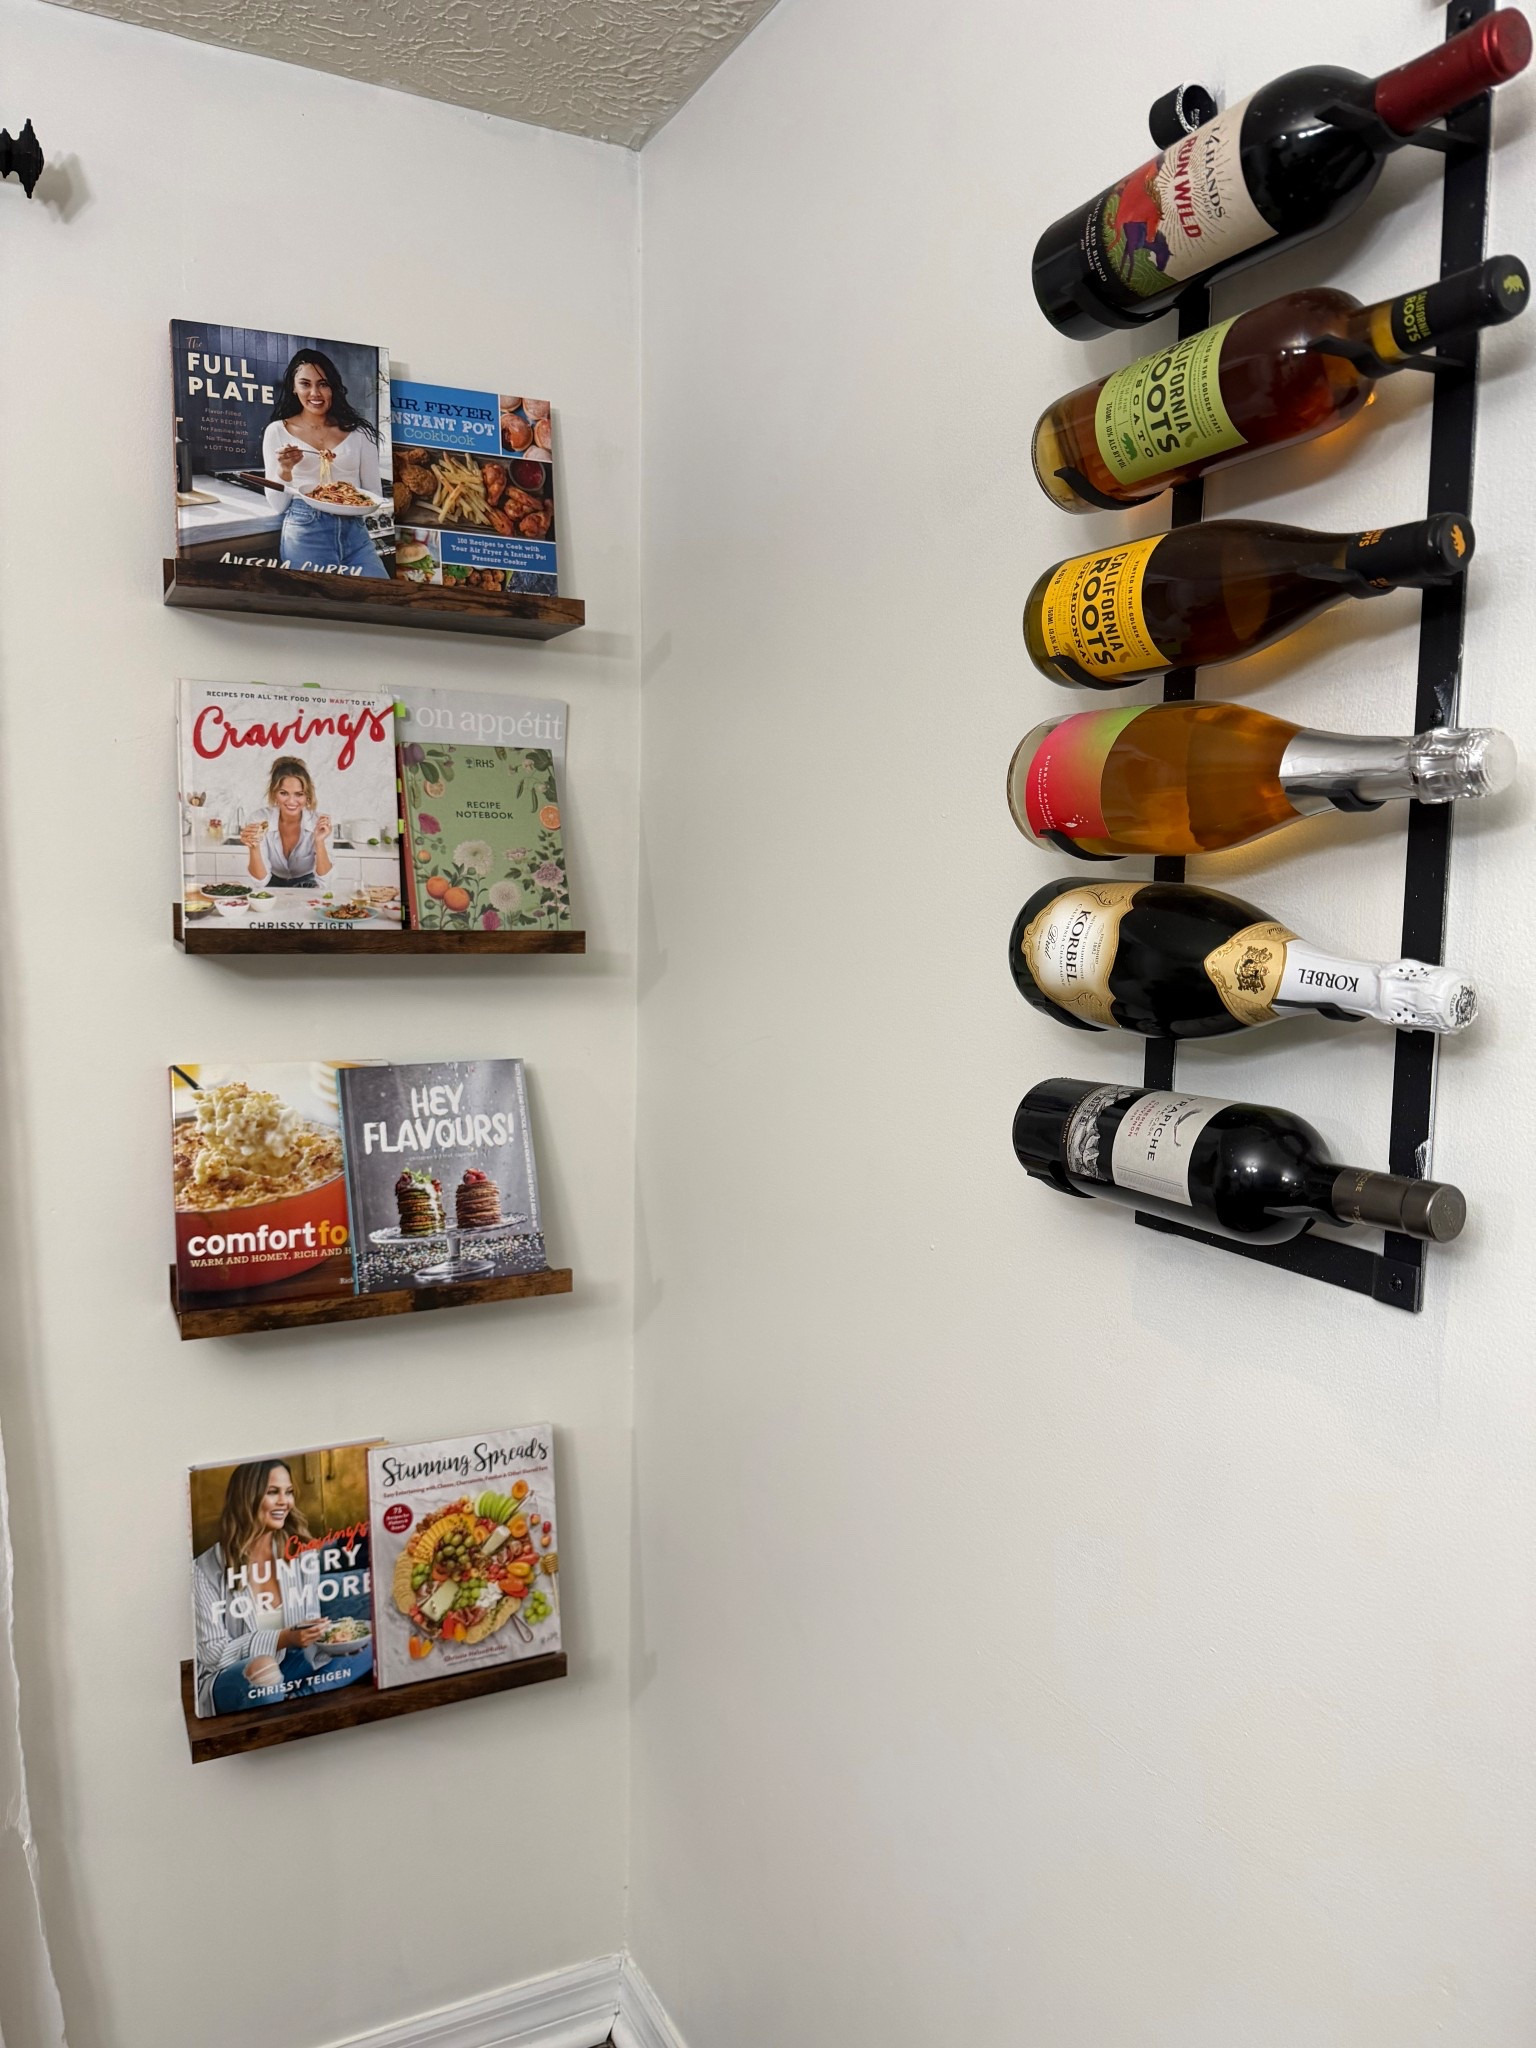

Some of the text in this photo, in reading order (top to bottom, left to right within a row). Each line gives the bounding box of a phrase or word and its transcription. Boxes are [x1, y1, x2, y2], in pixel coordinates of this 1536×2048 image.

[1174, 135, 1199, 179] RUN
[1200, 183, 1214, 220] WINERY
[1205, 149, 1226, 219] HANDS
[1174, 179, 1202, 238] WILD
[1086, 247, 1095, 270] VALLEY
[1092, 249, 1108, 282] BLEND
[1403, 295, 1421, 342] ROOTS
[1415, 290, 1432, 338] CALIFORNIA
[185, 335, 203, 350] The
[187, 352, 255, 379] FULL
[188, 376, 275, 405] PLATE
[1202, 383, 1212, 412] GOLDEN
[1209, 413, 1224, 433] STATE
[220, 418, 247, 427] RECIPES
[391, 411, 495, 437] NSTANT POT
[425, 401, 494, 422] FRYER
[404, 427, 476, 446] Cookbook
[469, 538, 496, 548] Recipes
[506, 542, 523, 551] Cook
[472, 554, 527, 566] Pressure Cooker
[482, 548, 503, 557] Fryer
[511, 551, 534, 560] Instant
[1070, 561, 1095, 666] CHARDONNAY
[1082, 556, 1116, 665] ROOTS
[1101, 552, 1128, 652] CALIFORNIA
[1128, 612, 1139, 639] GOLDEN
[1138, 640, 1151, 657] STATE
[206, 690, 239, 698] RECIPES
[290, 695, 310, 703] FOOD
[193, 704, 395, 771] Cravings
[459, 711, 565, 744] appétit
[475, 758, 495, 769] RHS
[456, 811, 514, 820] NOTEBOOK
[466, 800, 501, 810] RECIPE
[249, 921, 354, 931] CHRISSY TEIGEN
[1061, 903, 1082, 943] CALIFORNIA
[1065, 909, 1092, 983] KORBEL
[1298, 968, 1359, 993] KORBEL
[410, 1082, 464, 1118] HEY
[363, 1112, 515, 1155] FLAVOURS!
[1128, 1100, 1156, 1137] SAUVIGNON
[1133, 1101, 1160, 1136] CABERNET
[1147, 1097, 1198, 1161] TRAPICHE
[188, 1220, 350, 1257] comfort fo
[190, 1258, 223, 1267] WARM
[226, 1256, 249, 1265] AND
[251, 1253, 291, 1263] HOMEY,
[294, 1250, 318, 1259] RICH
[320, 1248, 342, 1257] AND
[382, 1437, 549, 1487] Stunning Spreads
[285, 1521, 368, 1560] Cravings
[227, 1543, 362, 1590] HUNGRY
[211, 1571, 371, 1624] FOR MORE
[247, 1668, 352, 1699] CHRISSY TEIGEN
